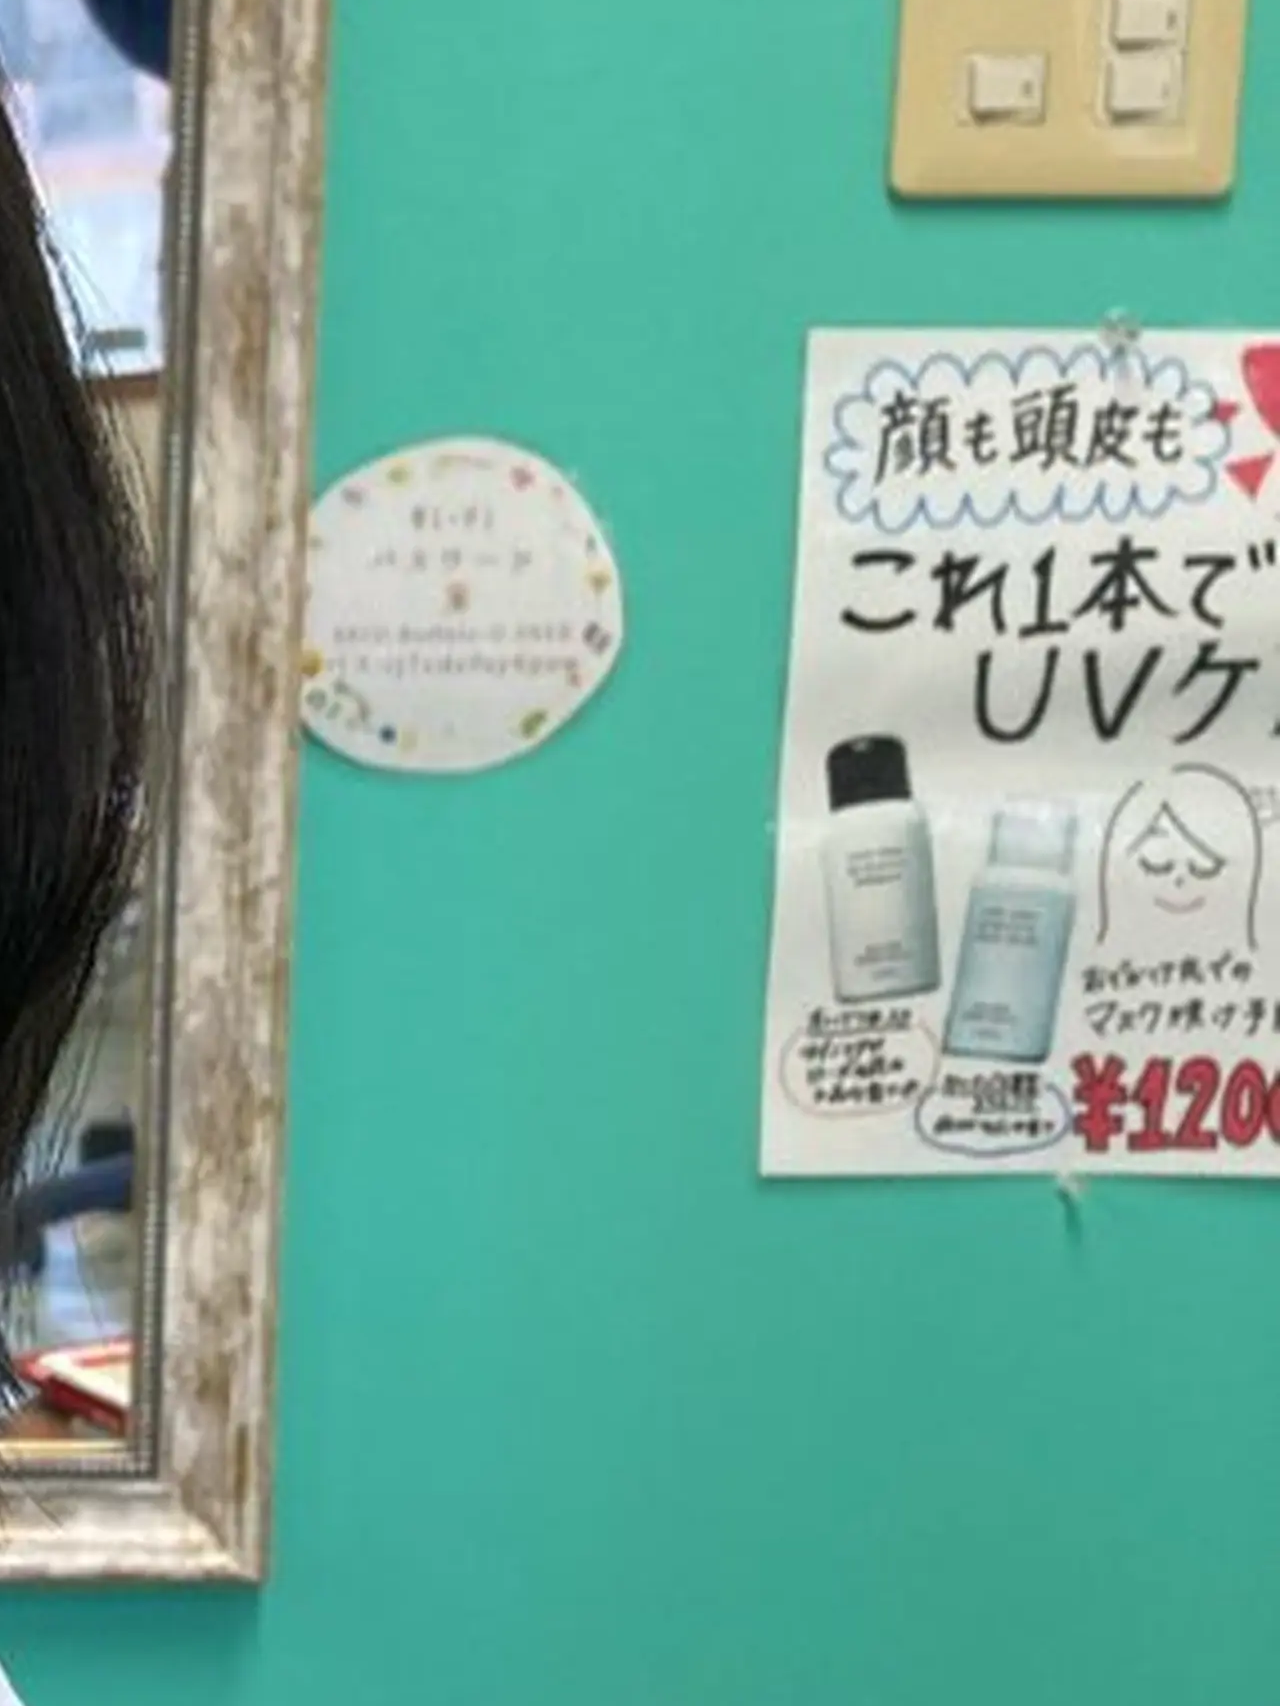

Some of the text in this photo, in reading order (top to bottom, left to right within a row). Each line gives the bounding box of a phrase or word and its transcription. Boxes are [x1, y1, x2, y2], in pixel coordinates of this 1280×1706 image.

[873, 383, 1186, 486] 顔も頭皮も
[842, 535, 1278, 639] これ1本で
[974, 640, 1280, 747] UVケ
[1083, 997, 1280, 1038] マスク焼け予
